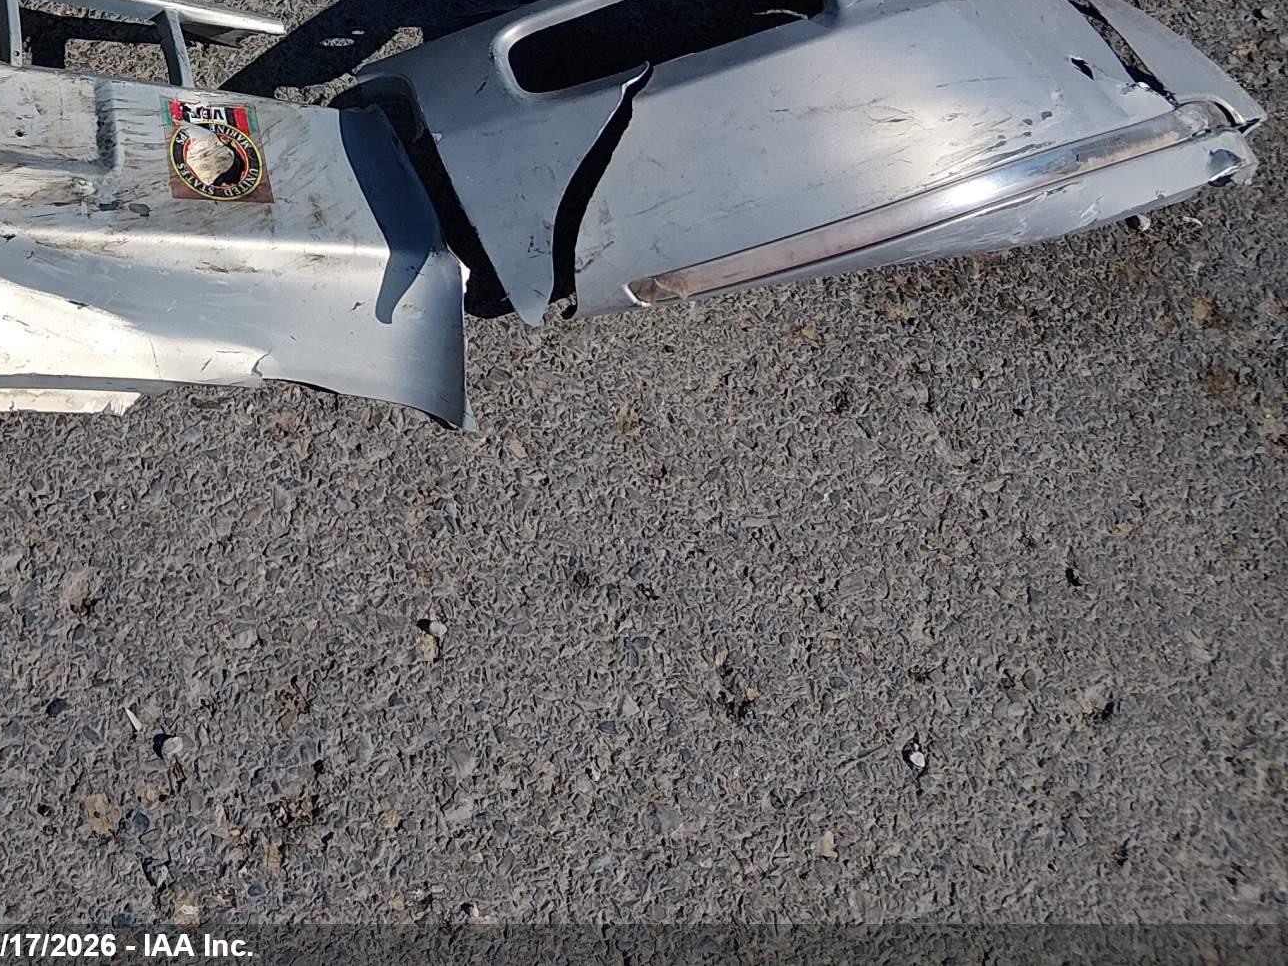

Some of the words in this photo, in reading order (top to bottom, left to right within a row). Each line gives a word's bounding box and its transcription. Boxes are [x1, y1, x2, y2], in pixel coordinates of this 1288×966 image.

[190, 107, 224, 120] VET
[208, 124, 251, 149] MARINE
[177, 162, 215, 194] STATES
[224, 168, 258, 196] UNITED
